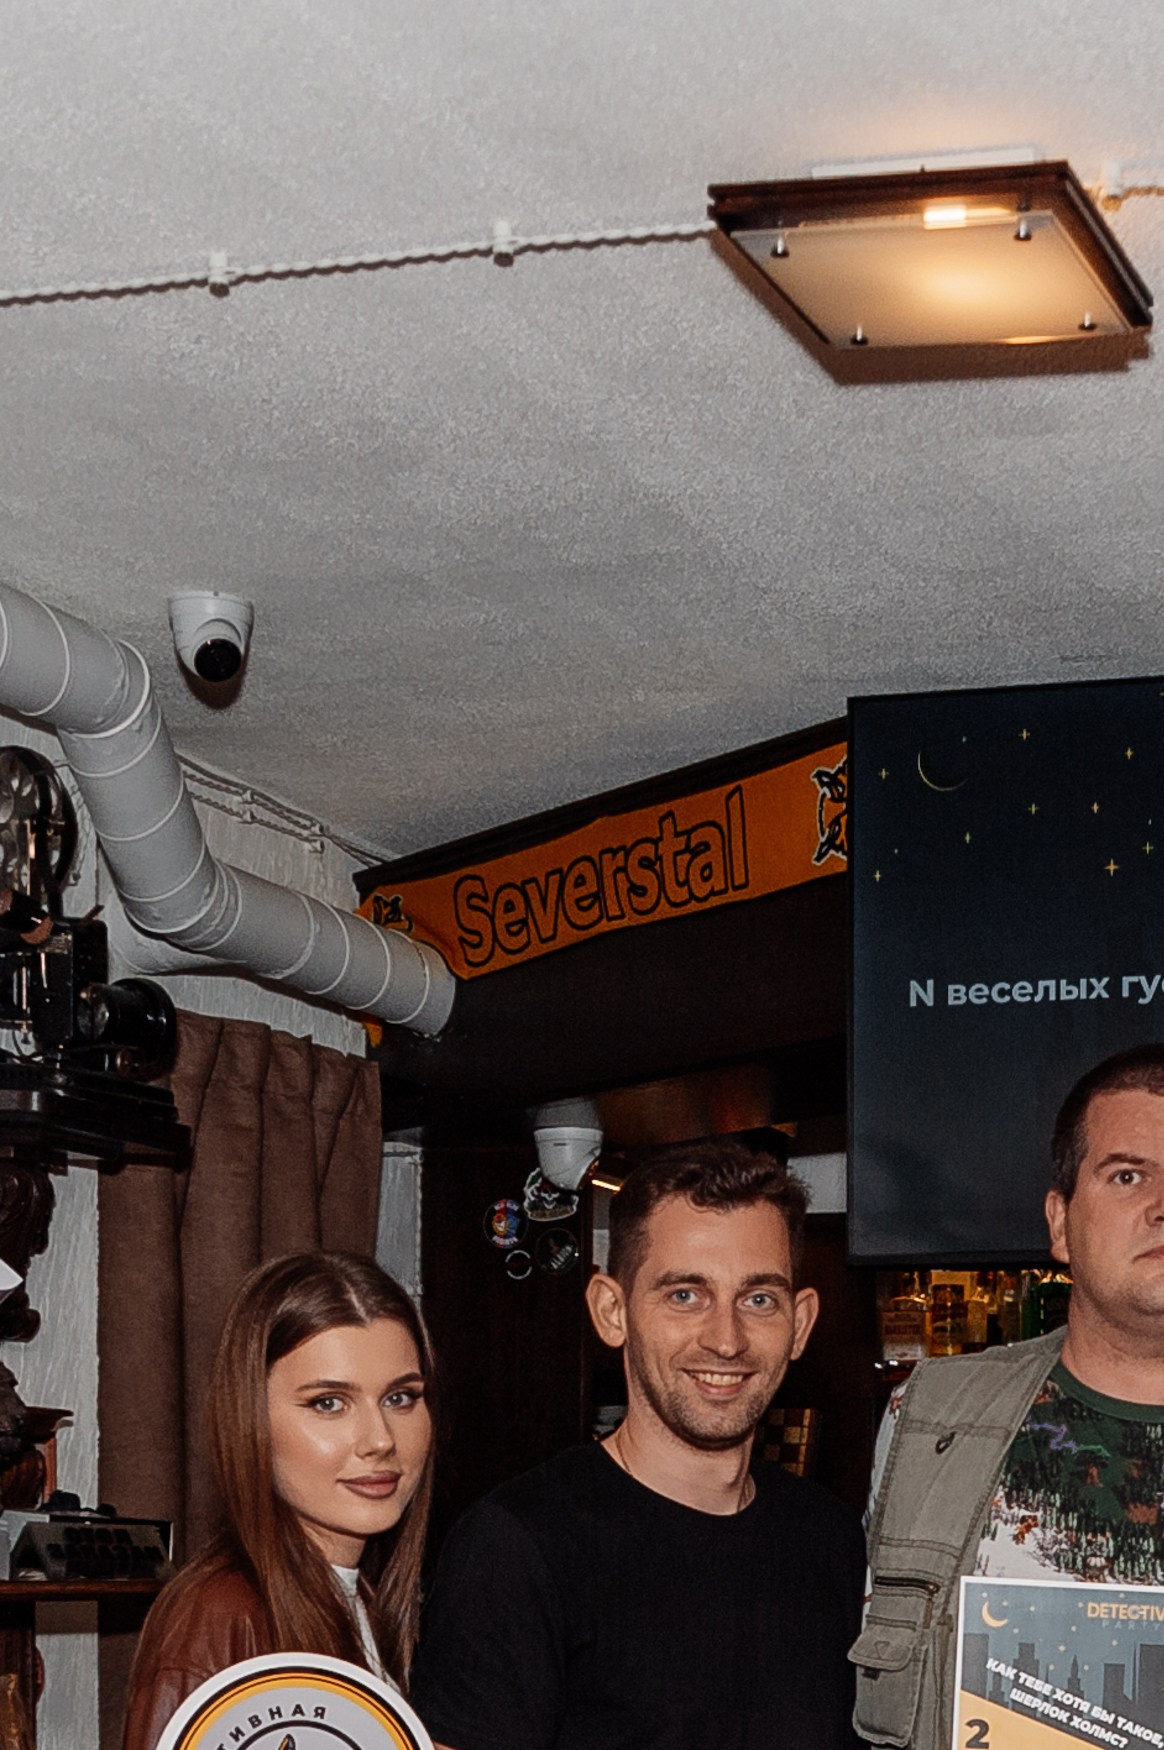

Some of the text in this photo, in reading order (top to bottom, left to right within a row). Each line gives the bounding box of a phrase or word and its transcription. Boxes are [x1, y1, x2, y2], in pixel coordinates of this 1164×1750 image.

[452, 784, 750, 967] Severstal
[909, 979, 934, 1007] N
[947, 976, 1110, 1005] веселых
[1102, 1620, 1161, 1632] PARTY
[986, 1657, 1164, 1749] КАК ТЕБЕ ХОТЯ БЫ ТАКОЕ,
[1009, 1687, 1129, 1750] ШЕРЛОК ХОЛМС?
[965, 1718, 990, 1750] 2
